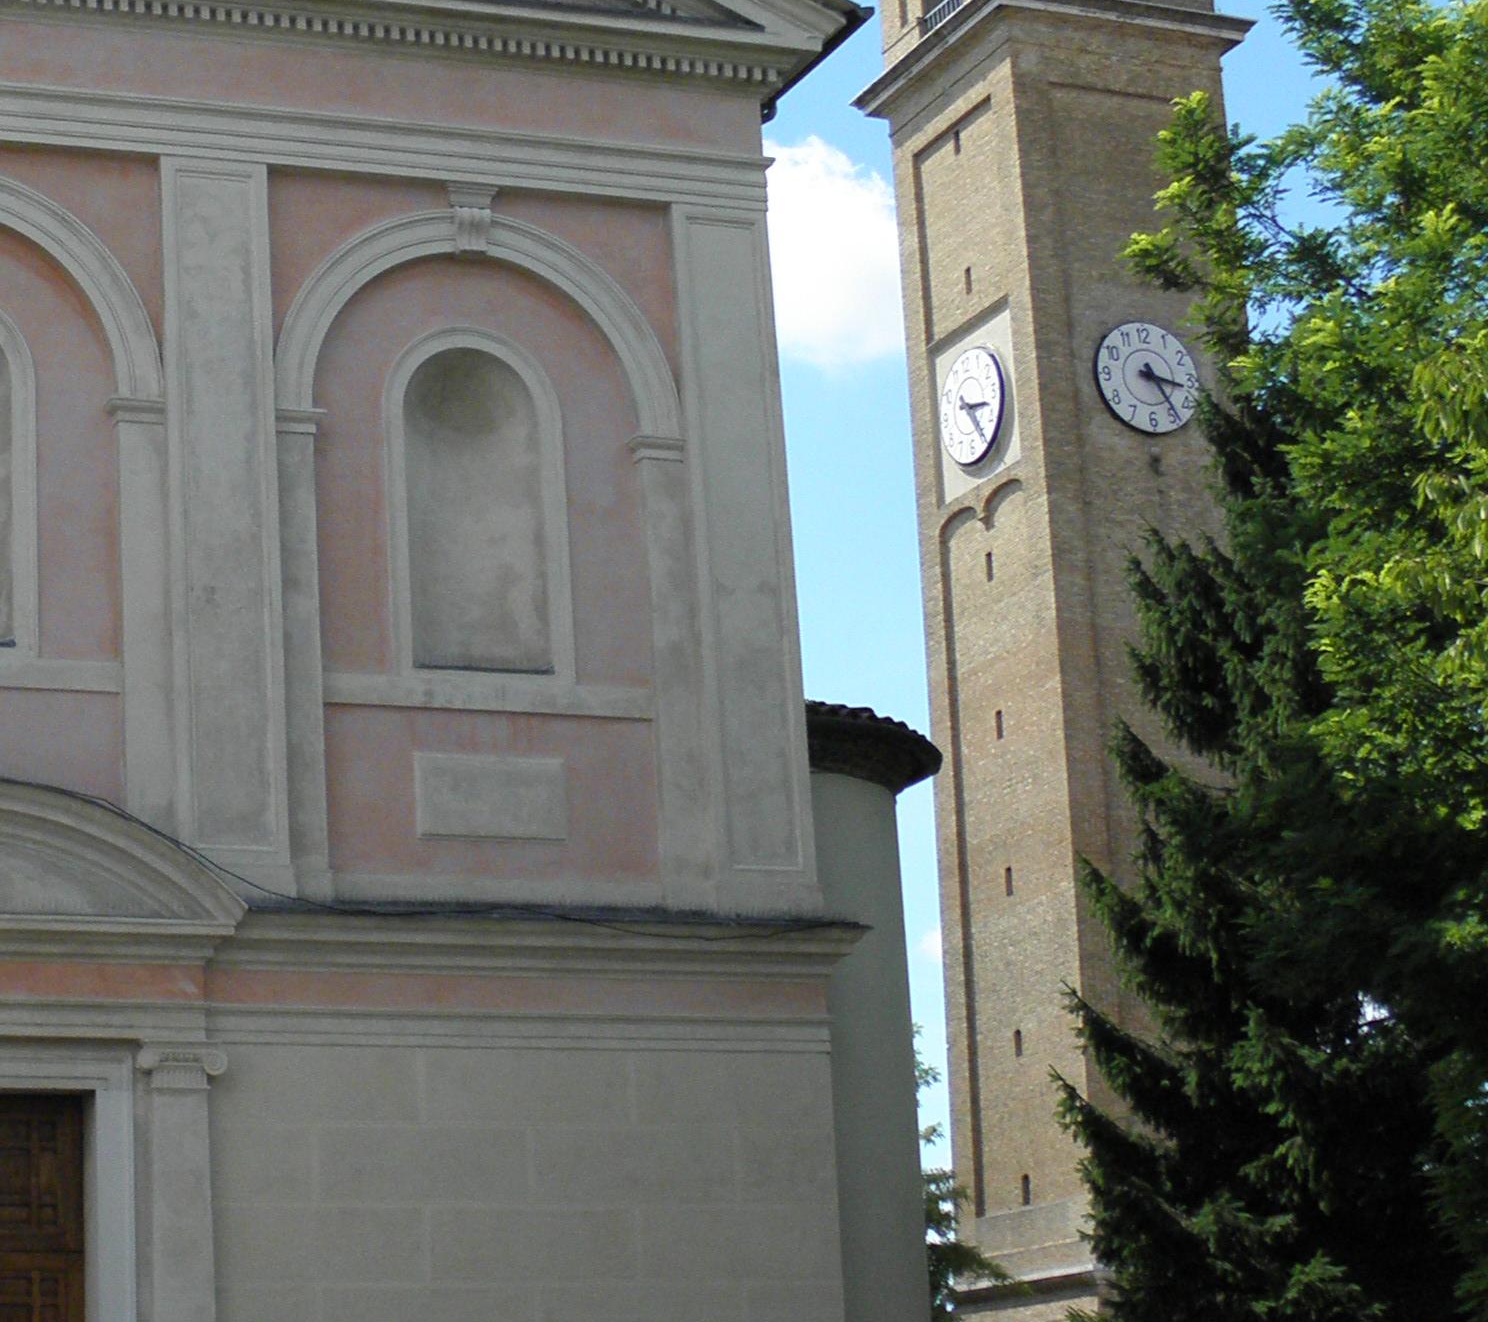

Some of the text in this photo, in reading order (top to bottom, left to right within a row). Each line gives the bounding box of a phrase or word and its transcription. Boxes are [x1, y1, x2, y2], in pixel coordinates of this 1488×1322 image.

[1120, 332, 1131, 347] 11
[1136, 328, 1151, 344] 12
[1161, 334, 1167, 349] 1
[1107, 345, 1120, 361] 10
[1176, 350, 1185, 366] 2
[962, 357, 970, 374] 12
[1102, 366, 1111, 381] 9
[1185, 374, 1195, 389] 3
[1112, 389, 1121, 405] 8
[1182, 396, 1194, 410] 4
[1128, 405, 1137, 422] 7
[1148, 411, 1158, 427] 6
[1167, 408, 1176, 424] 5
